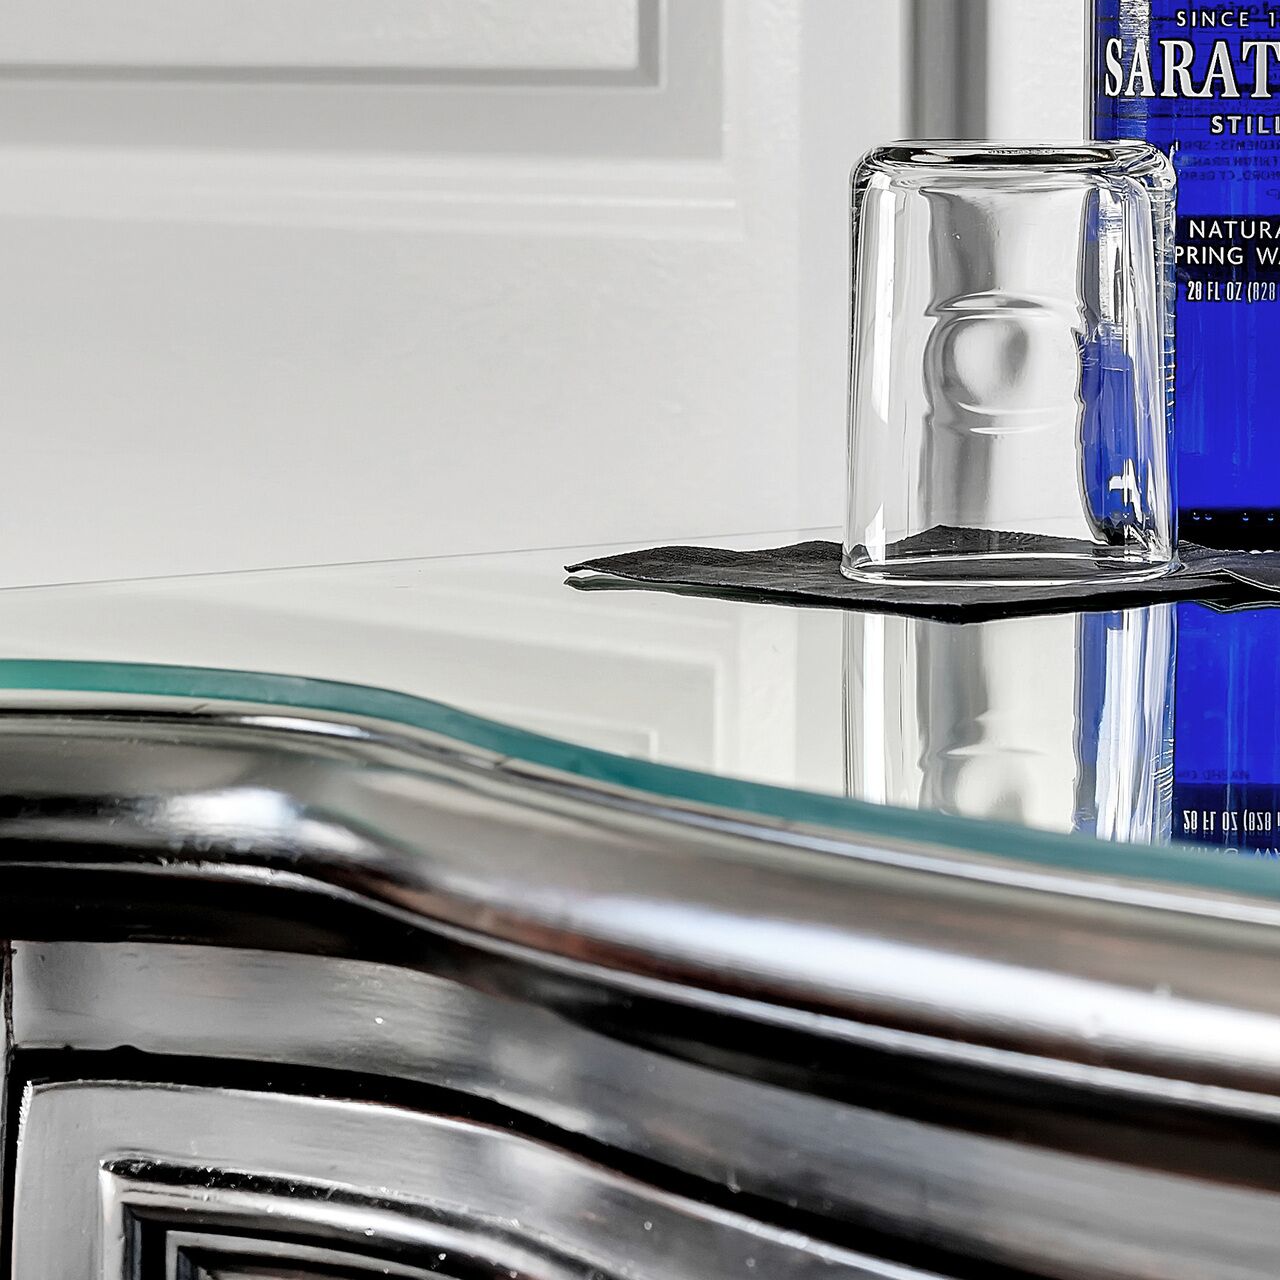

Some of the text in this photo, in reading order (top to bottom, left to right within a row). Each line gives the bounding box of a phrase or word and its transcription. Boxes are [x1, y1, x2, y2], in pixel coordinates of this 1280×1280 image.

[1176, 11, 1249, 27] SINCE
[1174, 246, 1244, 266] PRING
[1187, 281, 1202, 302] 28
[1207, 281, 1221, 302] FL
[1226, 281, 1242, 302] OZ
[1247, 280, 1276, 304] (828
